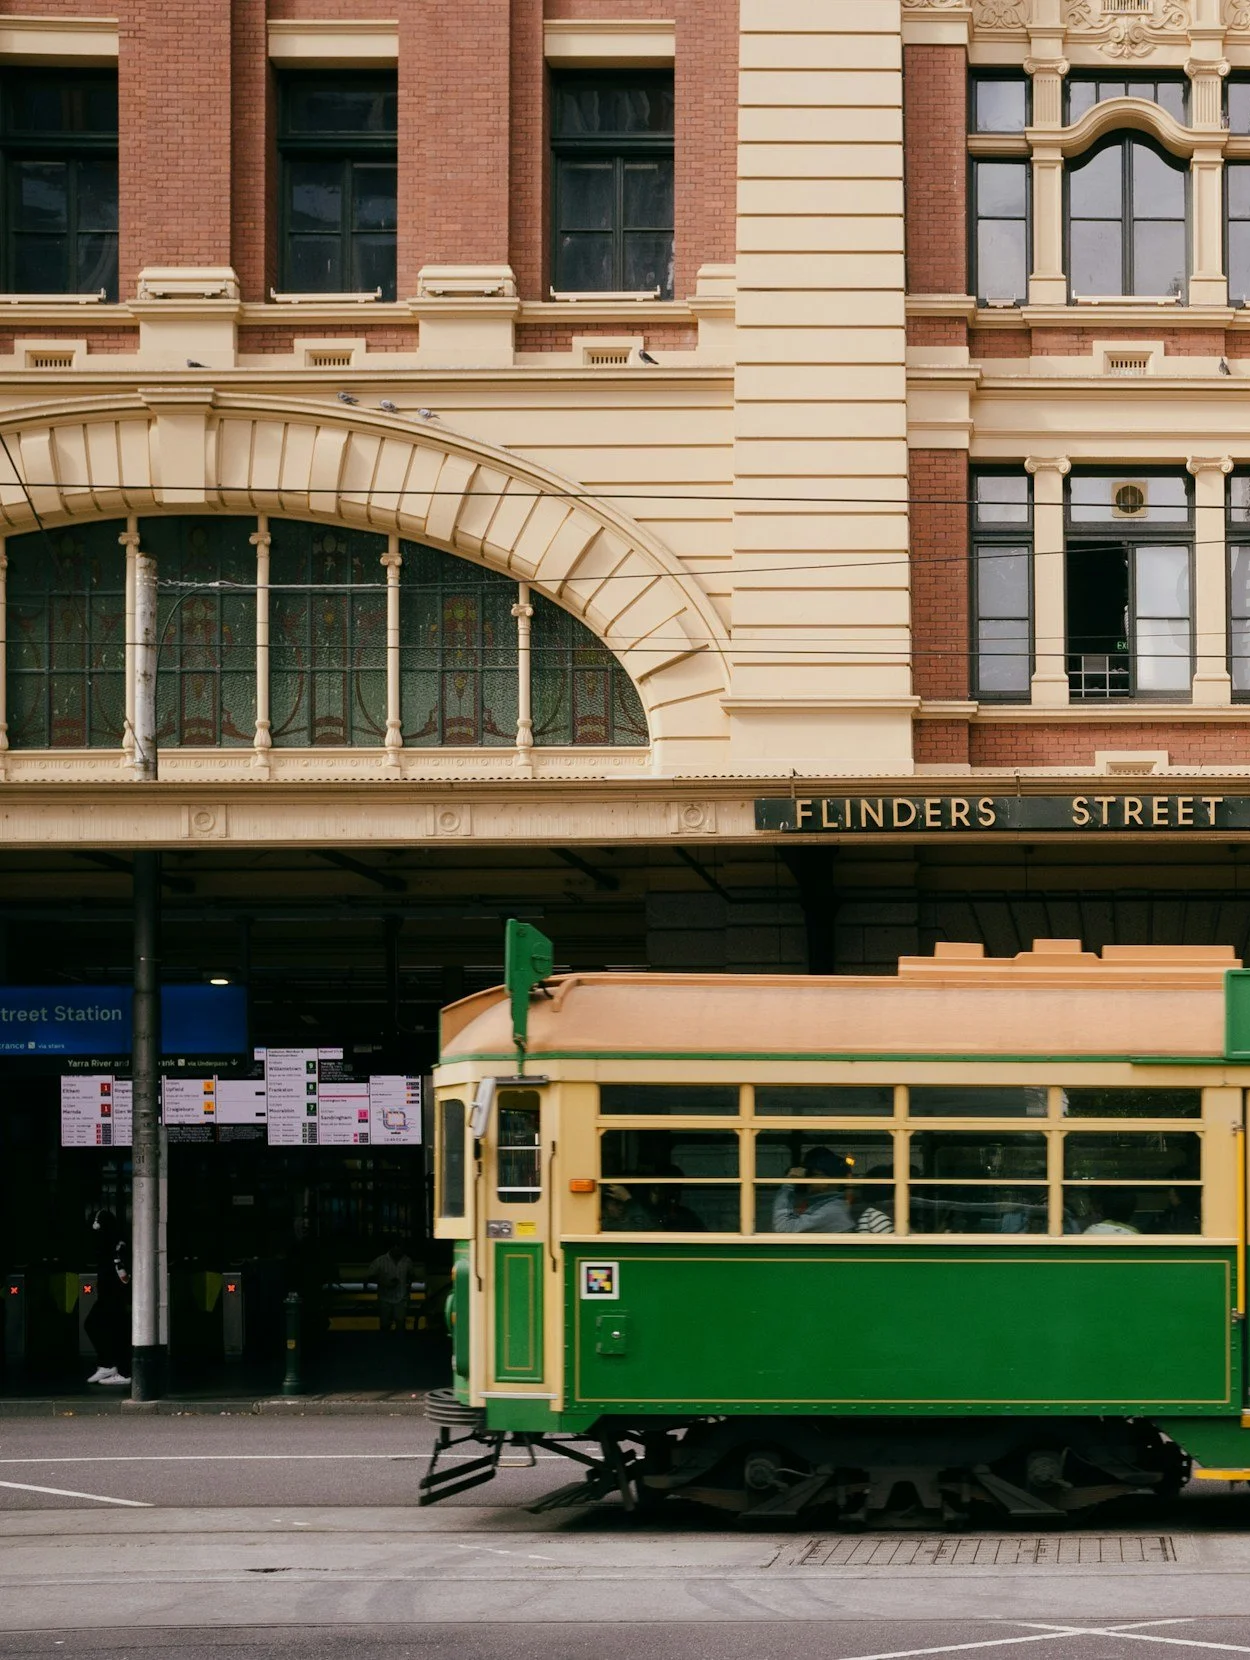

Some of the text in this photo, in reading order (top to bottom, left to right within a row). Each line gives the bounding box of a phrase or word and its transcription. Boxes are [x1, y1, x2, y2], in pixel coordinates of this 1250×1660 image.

[796, 797, 998, 829] FLINDERS
[1071, 797, 1226, 827] STREET
[0, 1004, 123, 1022] treet Station
[67, 1059, 89, 1067] Yarra
[91, 1059, 112, 1067] River
